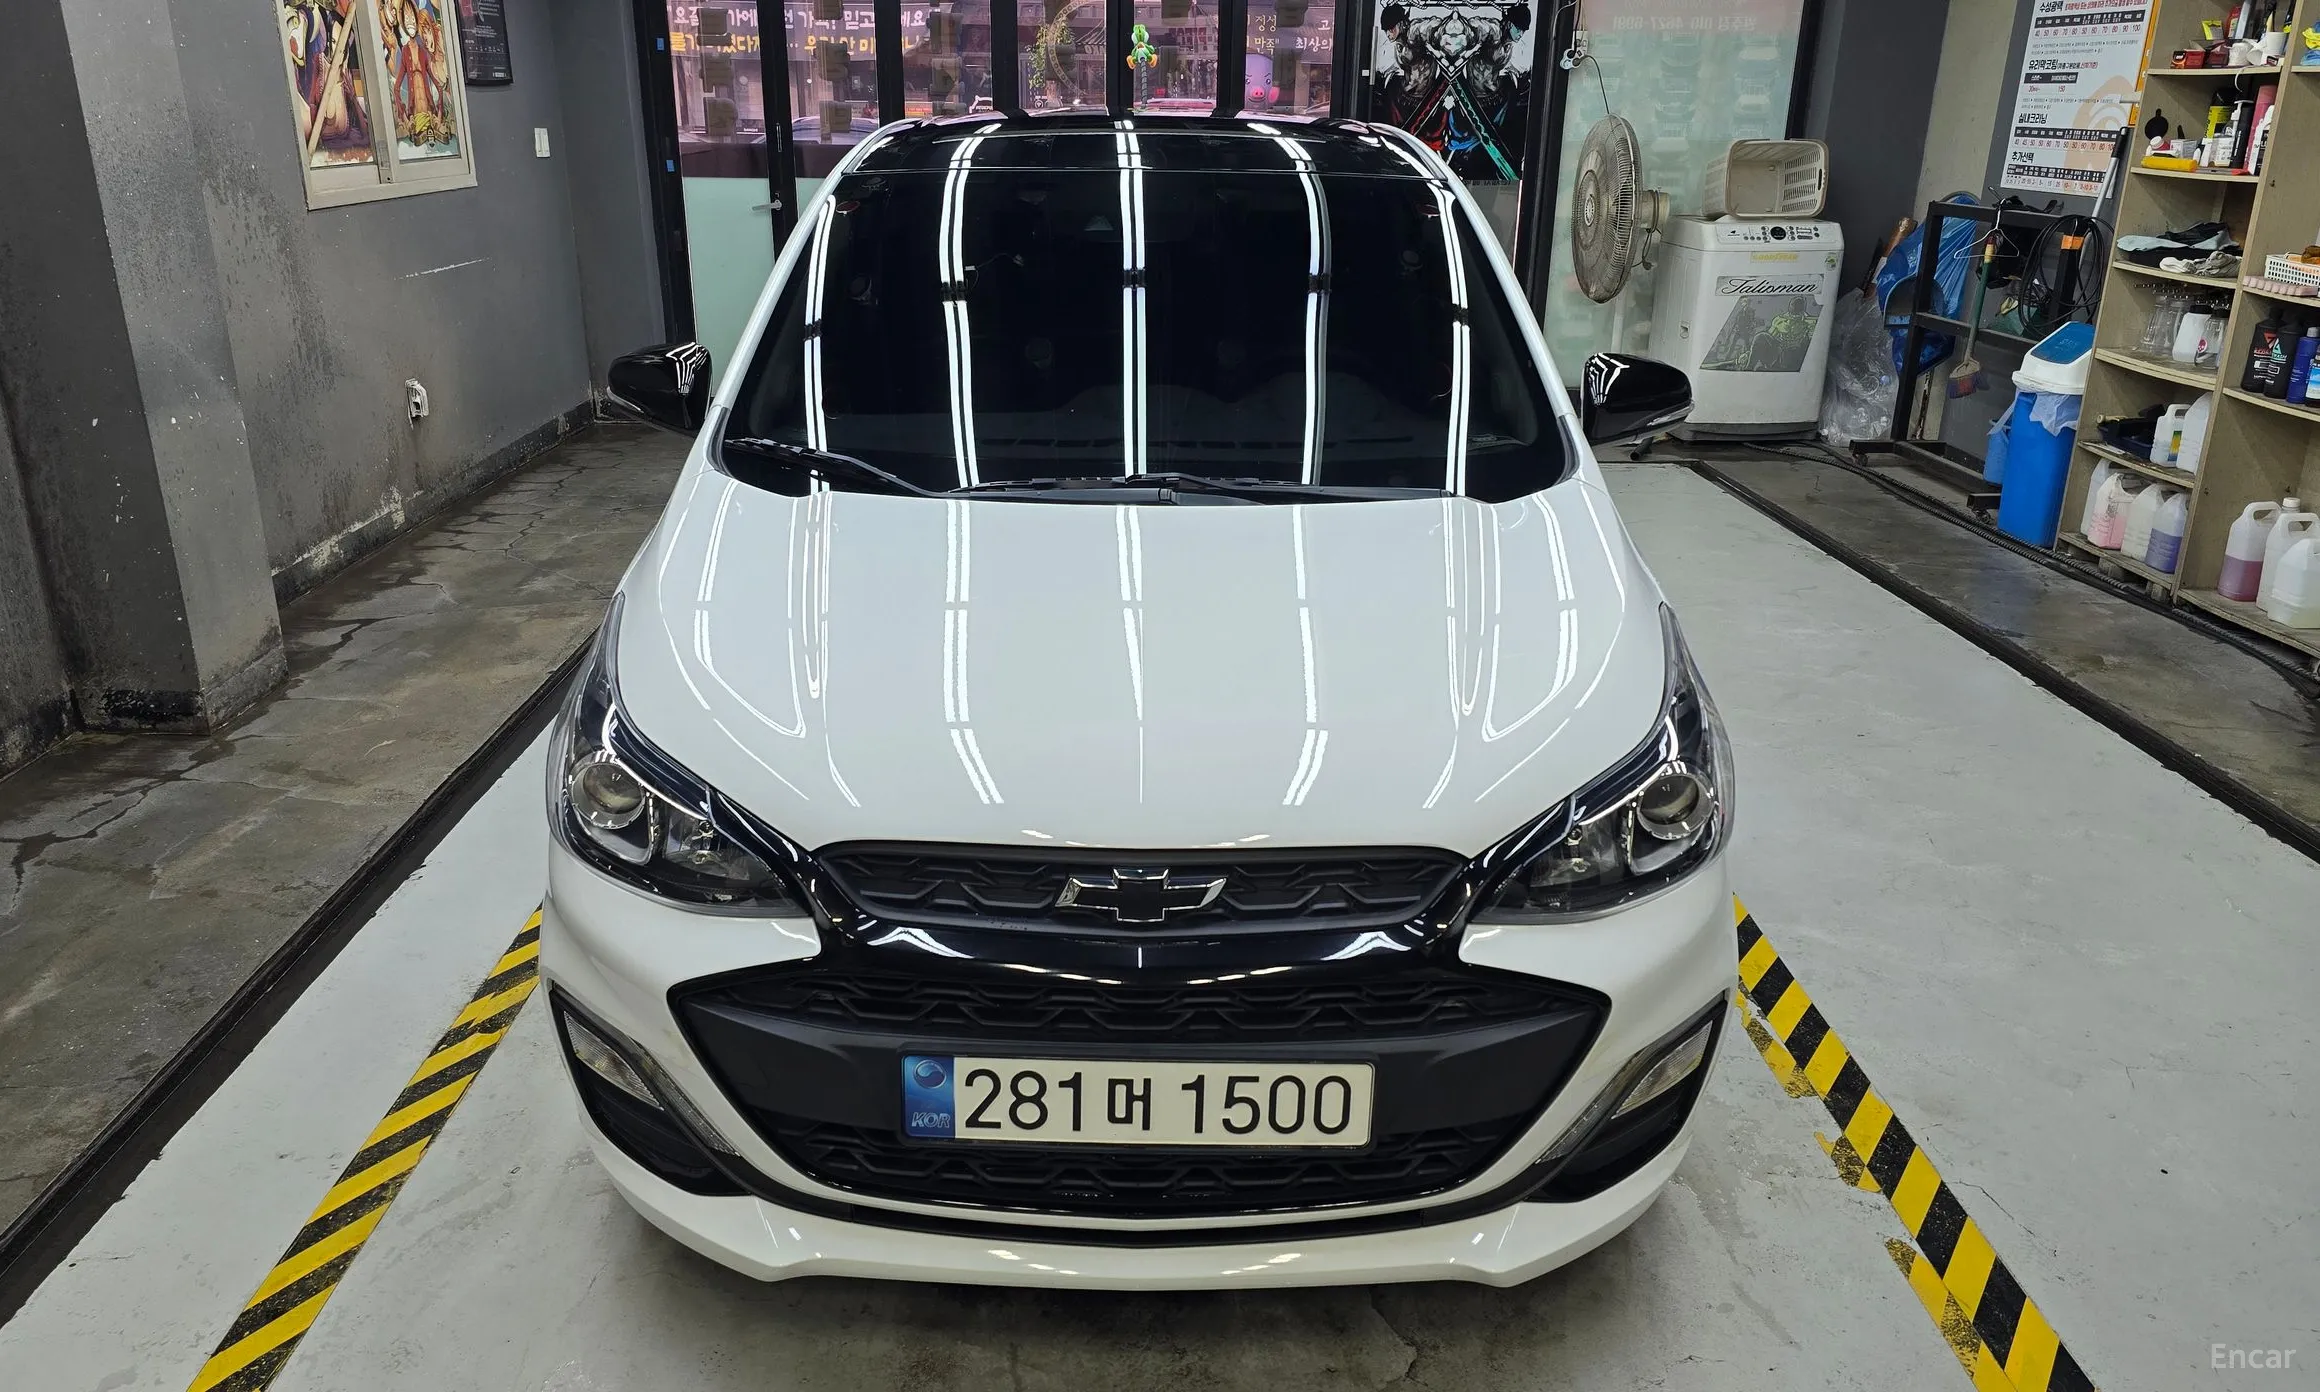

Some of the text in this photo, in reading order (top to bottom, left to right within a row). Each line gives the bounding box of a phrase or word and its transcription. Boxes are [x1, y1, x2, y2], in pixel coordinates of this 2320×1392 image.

[1255, 15, 1277, 32] 정성
[2029, 59, 2058, 70] 유리막코팅
[1721, 279, 1818, 294] Talisman
[1181, 1074, 1352, 1135] 1500
[911, 1112, 950, 1128] KOR
